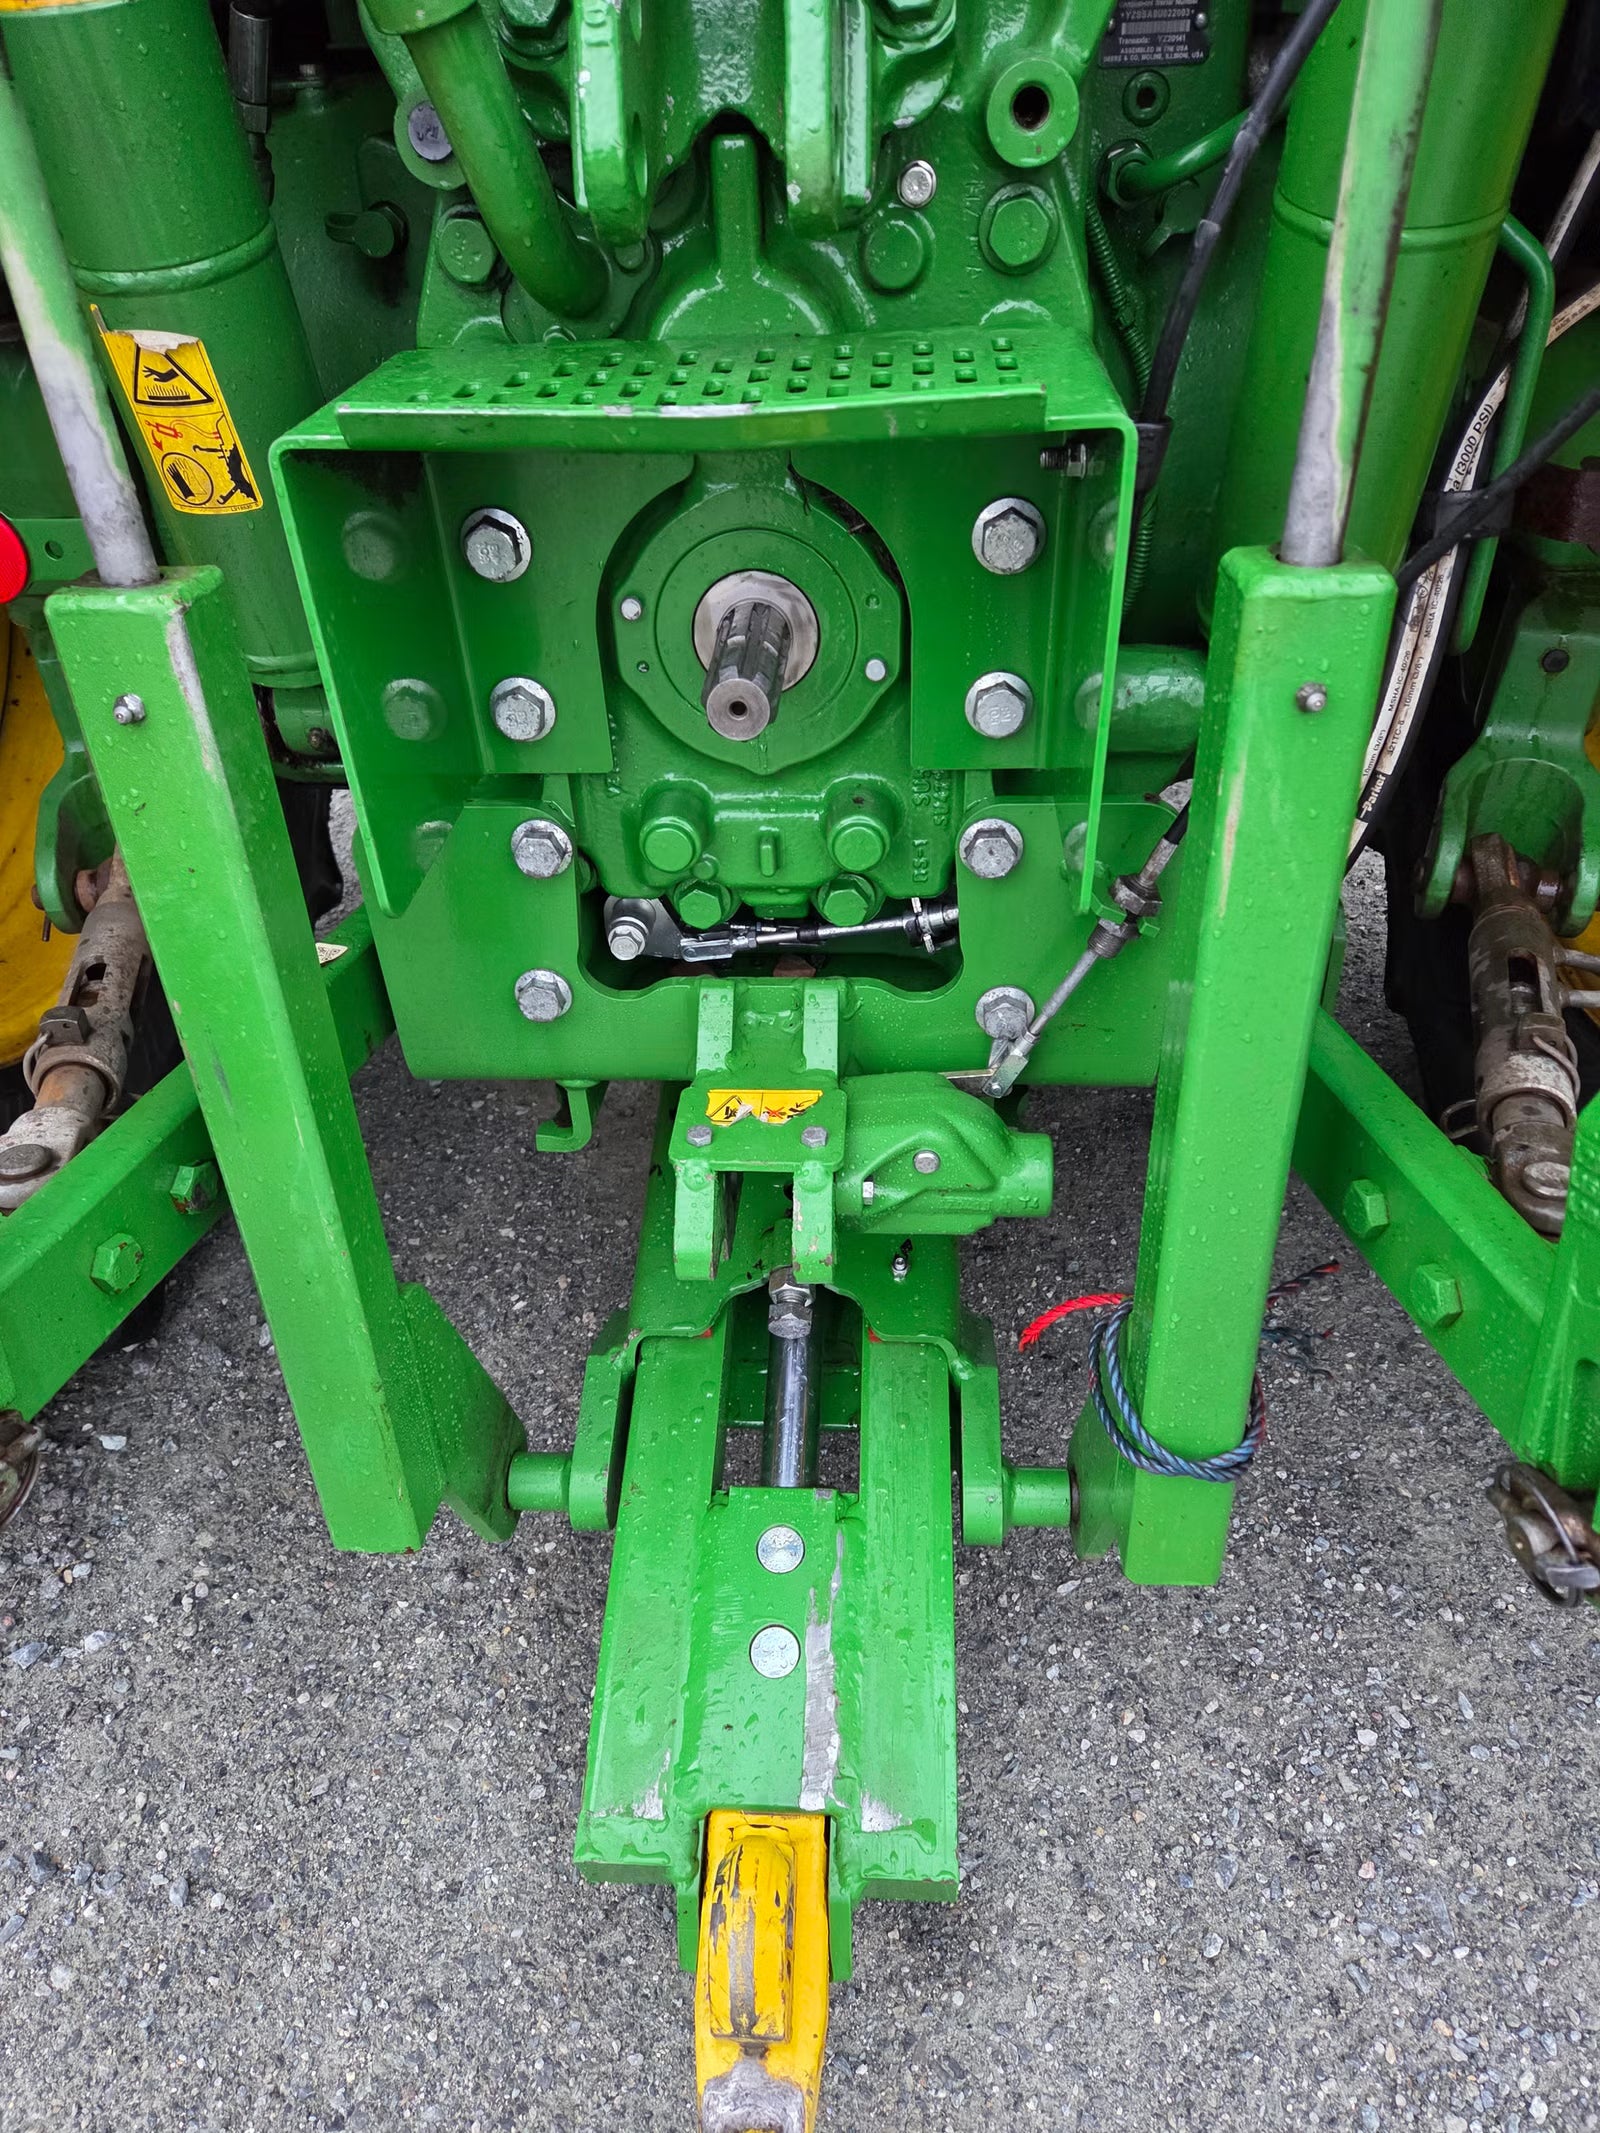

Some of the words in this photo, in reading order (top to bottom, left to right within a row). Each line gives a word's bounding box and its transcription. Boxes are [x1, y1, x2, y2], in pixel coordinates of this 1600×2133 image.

[1176, 44, 1189, 52] USA
[1191, 51, 1205, 59] USA
[1454, 435, 1478, 475] (3000
[1473, 402, 1494, 434] PSI)
[1387, 687, 1400, 712] MSHA
[1363, 774, 1386, 814] Parker
